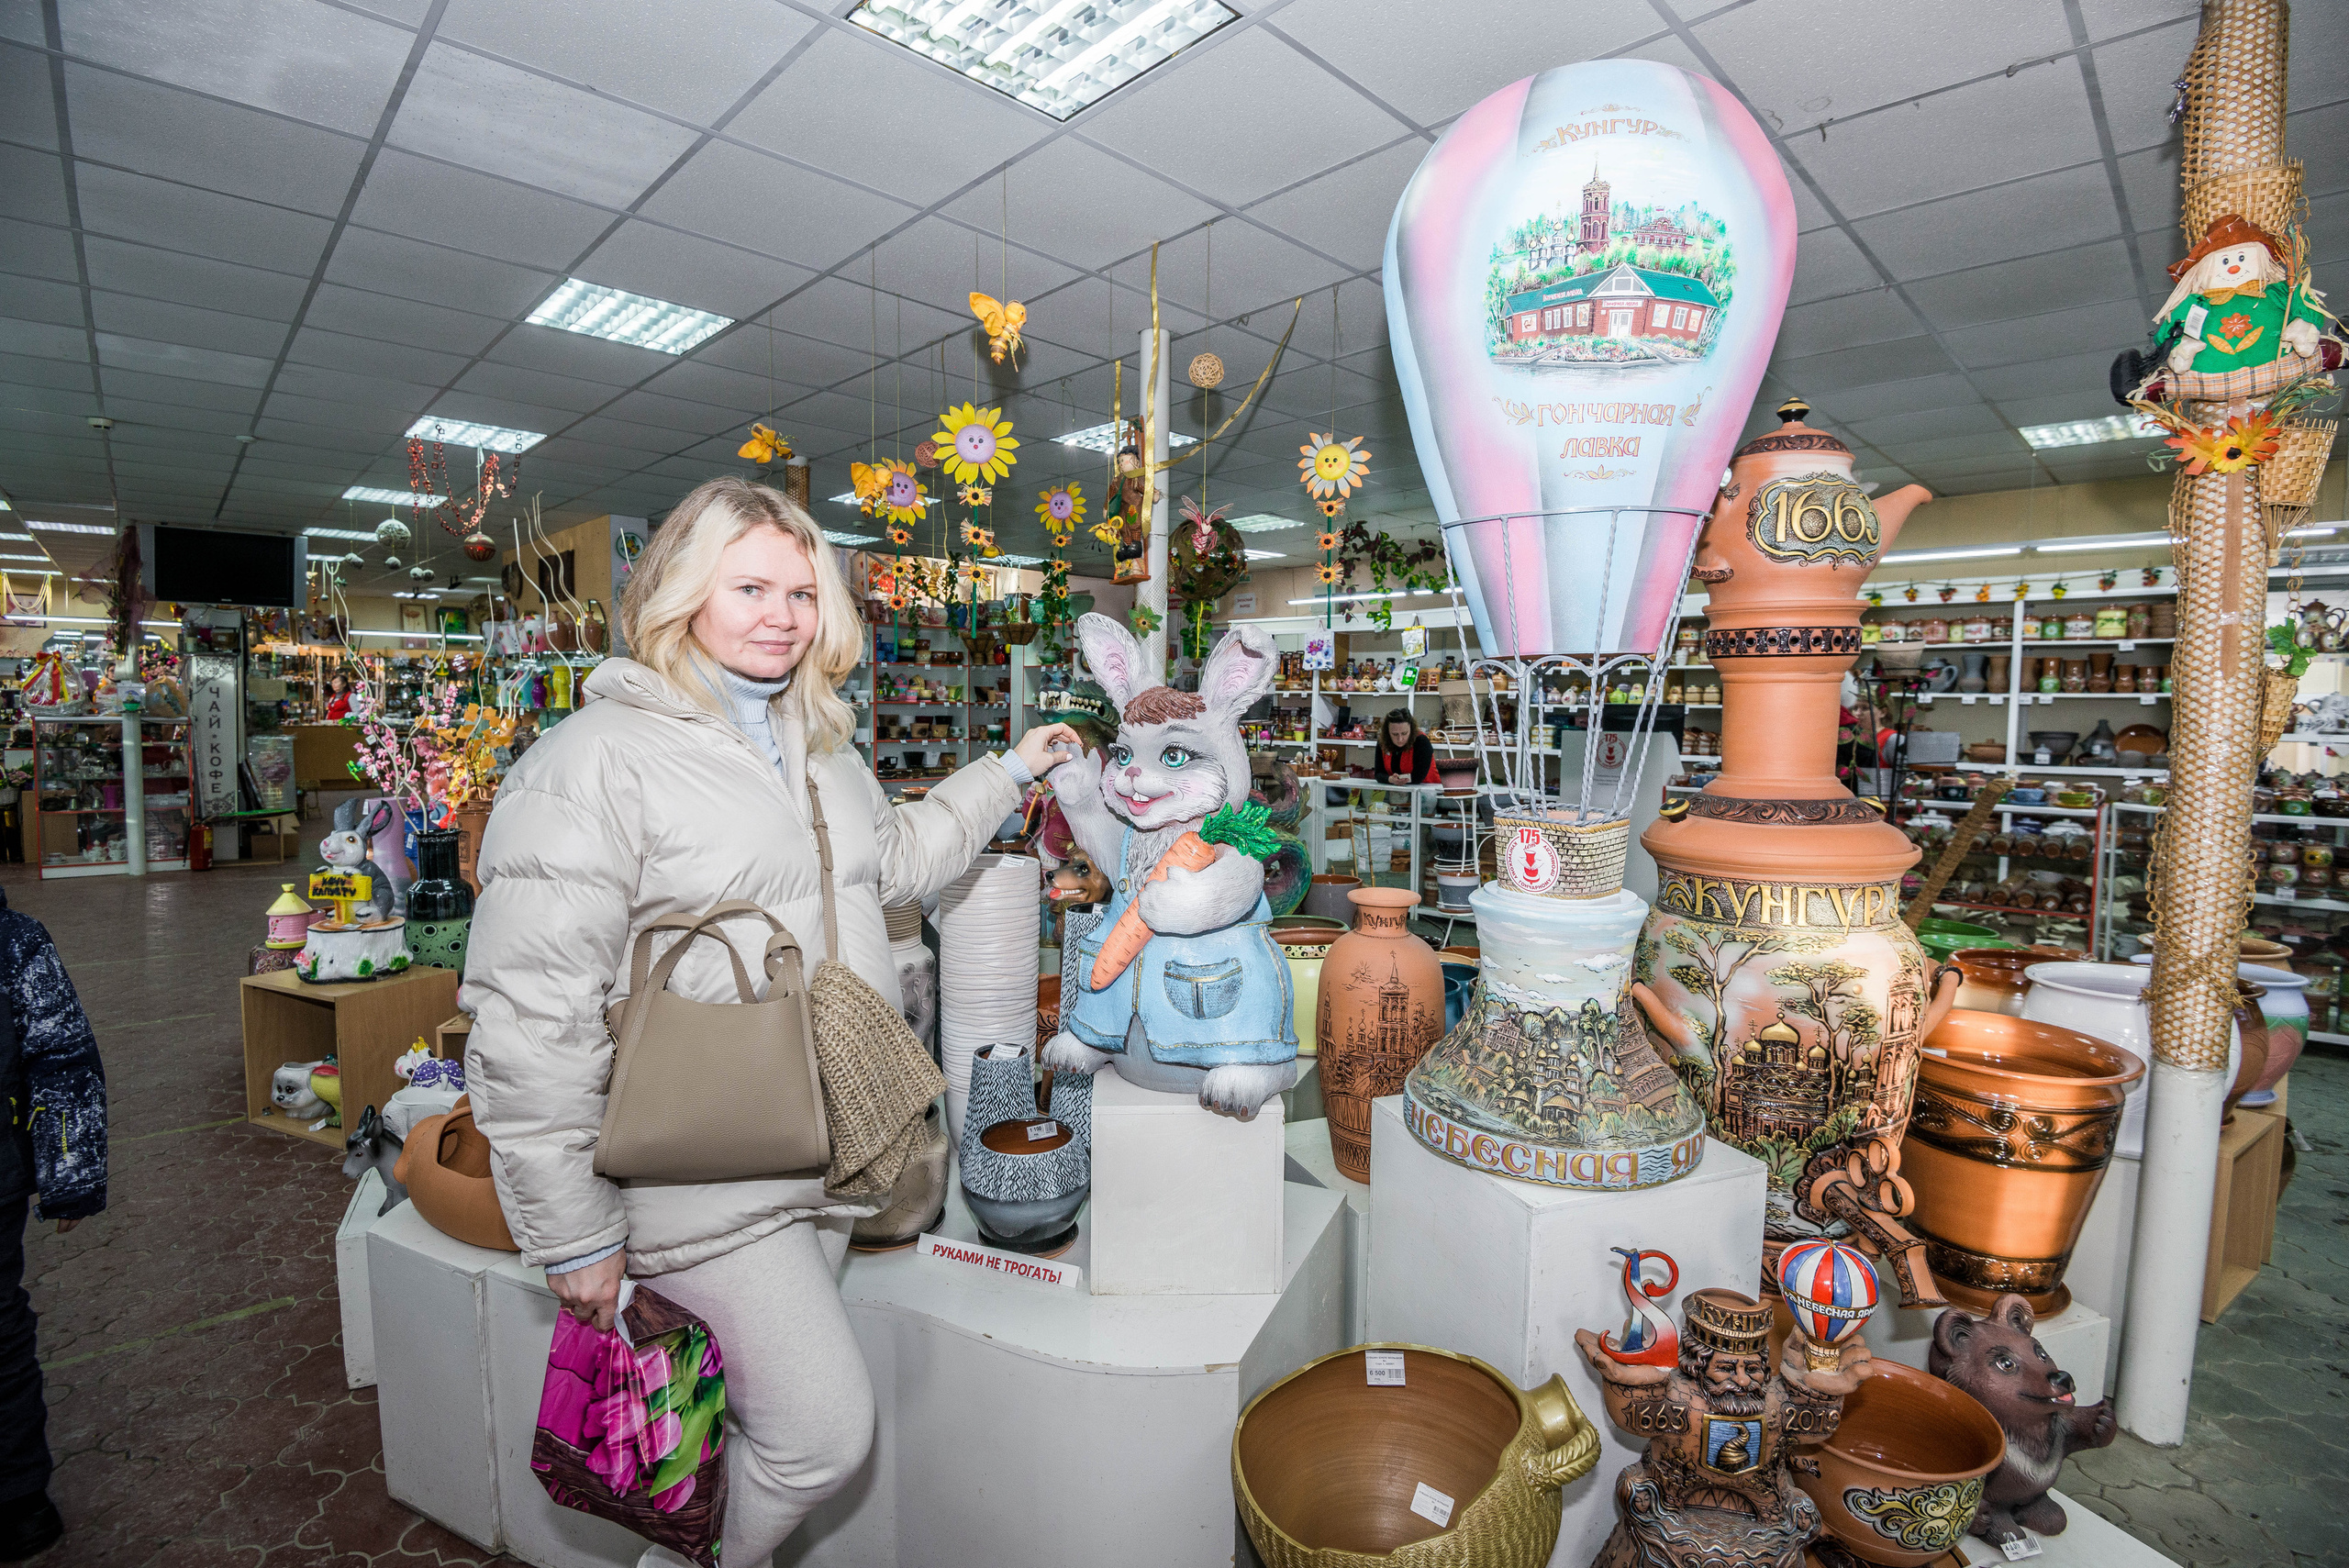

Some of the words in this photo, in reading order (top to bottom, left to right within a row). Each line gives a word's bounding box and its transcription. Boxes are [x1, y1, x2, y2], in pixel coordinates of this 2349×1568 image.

[1556, 118, 1658, 146] КУНГУР
[1537, 402, 1676, 427] ГОНЧАРНАЯ
[1560, 436, 1642, 459] ЛАВКА
[208, 686, 221, 729] ЧАЙ
[1605, 733, 1618, 742] 175
[208, 742, 223, 794] КОФЕ
[1518, 828, 1541, 845] 175
[1519, 877, 1552, 891] ГОНЧАРНОМУ
[1694, 877, 1885, 937] КУНГУР
[1410, 1099, 1639, 1184] НЕБЕСНАЯ
[932, 1244, 984, 1266] РУКАМИ
[985, 1255, 1002, 1270] НЕ
[1004, 1259, 1063, 1284] ТРОГАТЬ!
[1700, 1300, 1775, 1330] КУНГУР
[1797, 1296, 1856, 1319] НЕБЕСНАЯ
[1626, 1404, 1685, 1430] 1663
[1786, 1407, 1842, 1432] 2019
